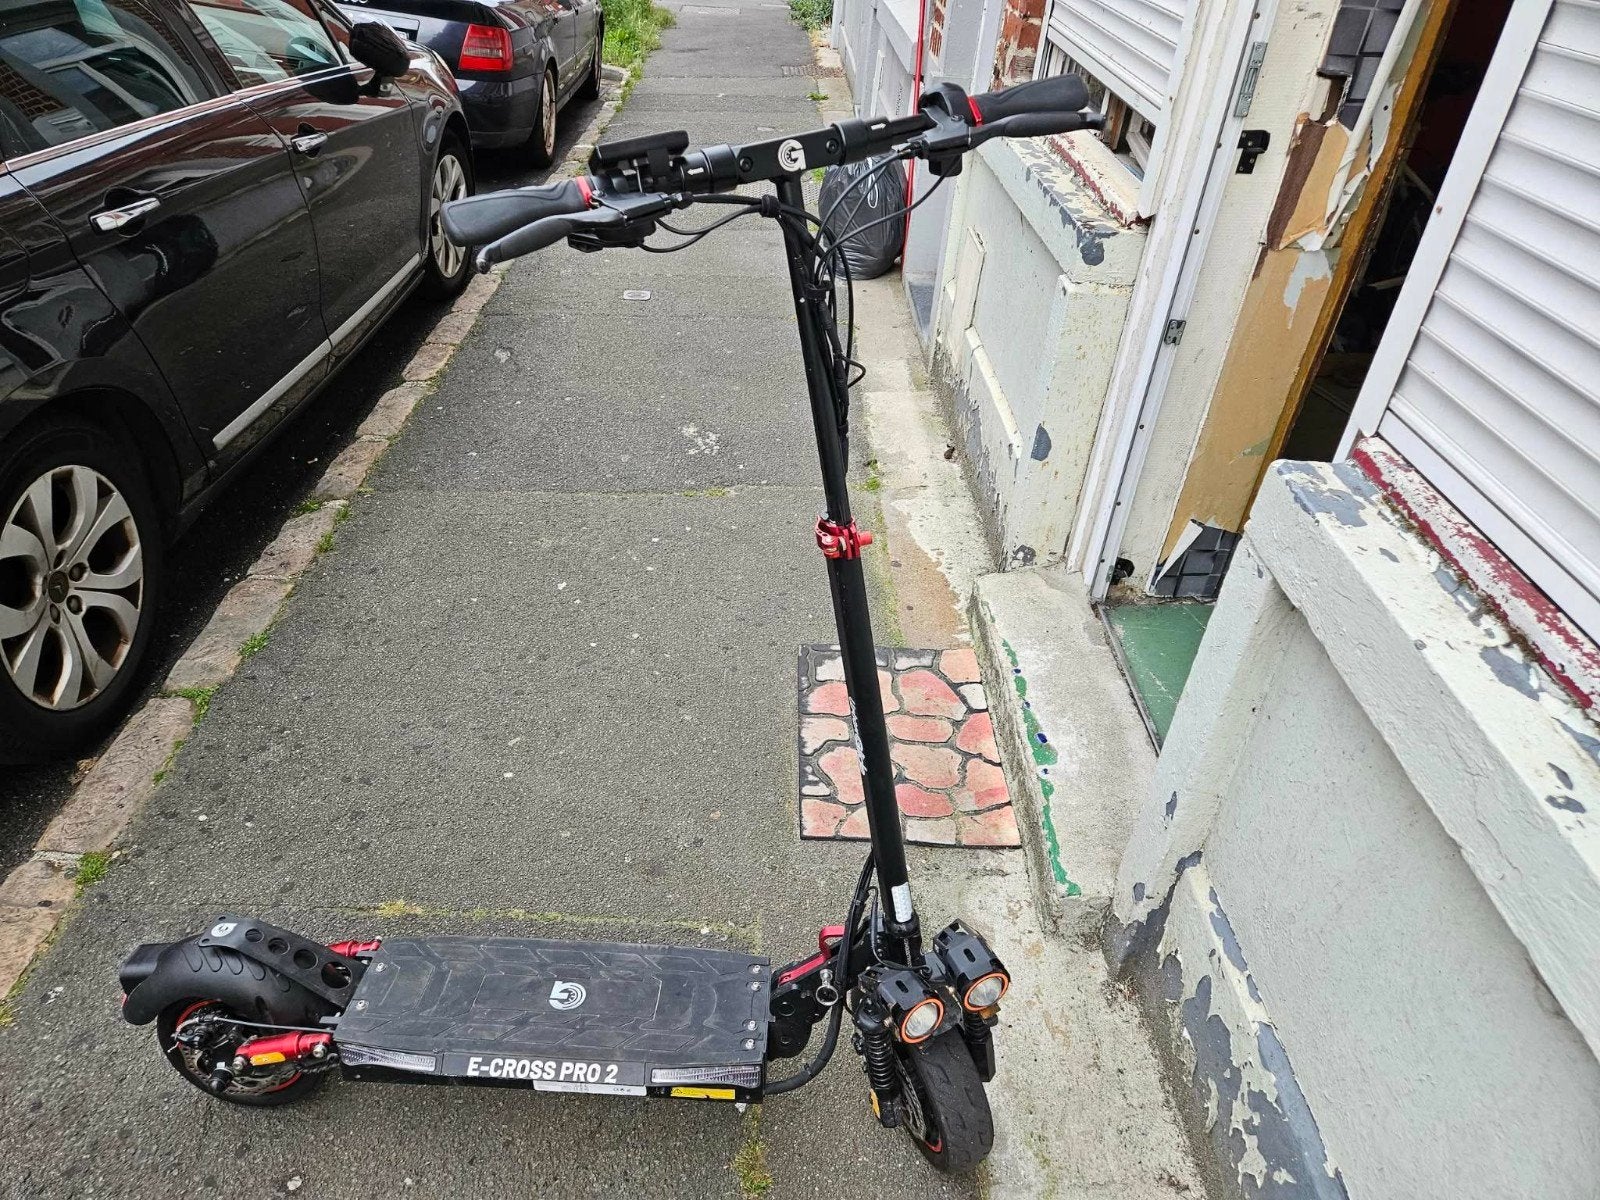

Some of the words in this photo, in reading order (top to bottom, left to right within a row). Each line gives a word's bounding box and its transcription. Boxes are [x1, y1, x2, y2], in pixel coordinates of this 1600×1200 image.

[467, 1057, 556, 1080] E-CROSS
[559, 1062, 601, 1082] PRO
[604, 1064, 619, 1084] 2
